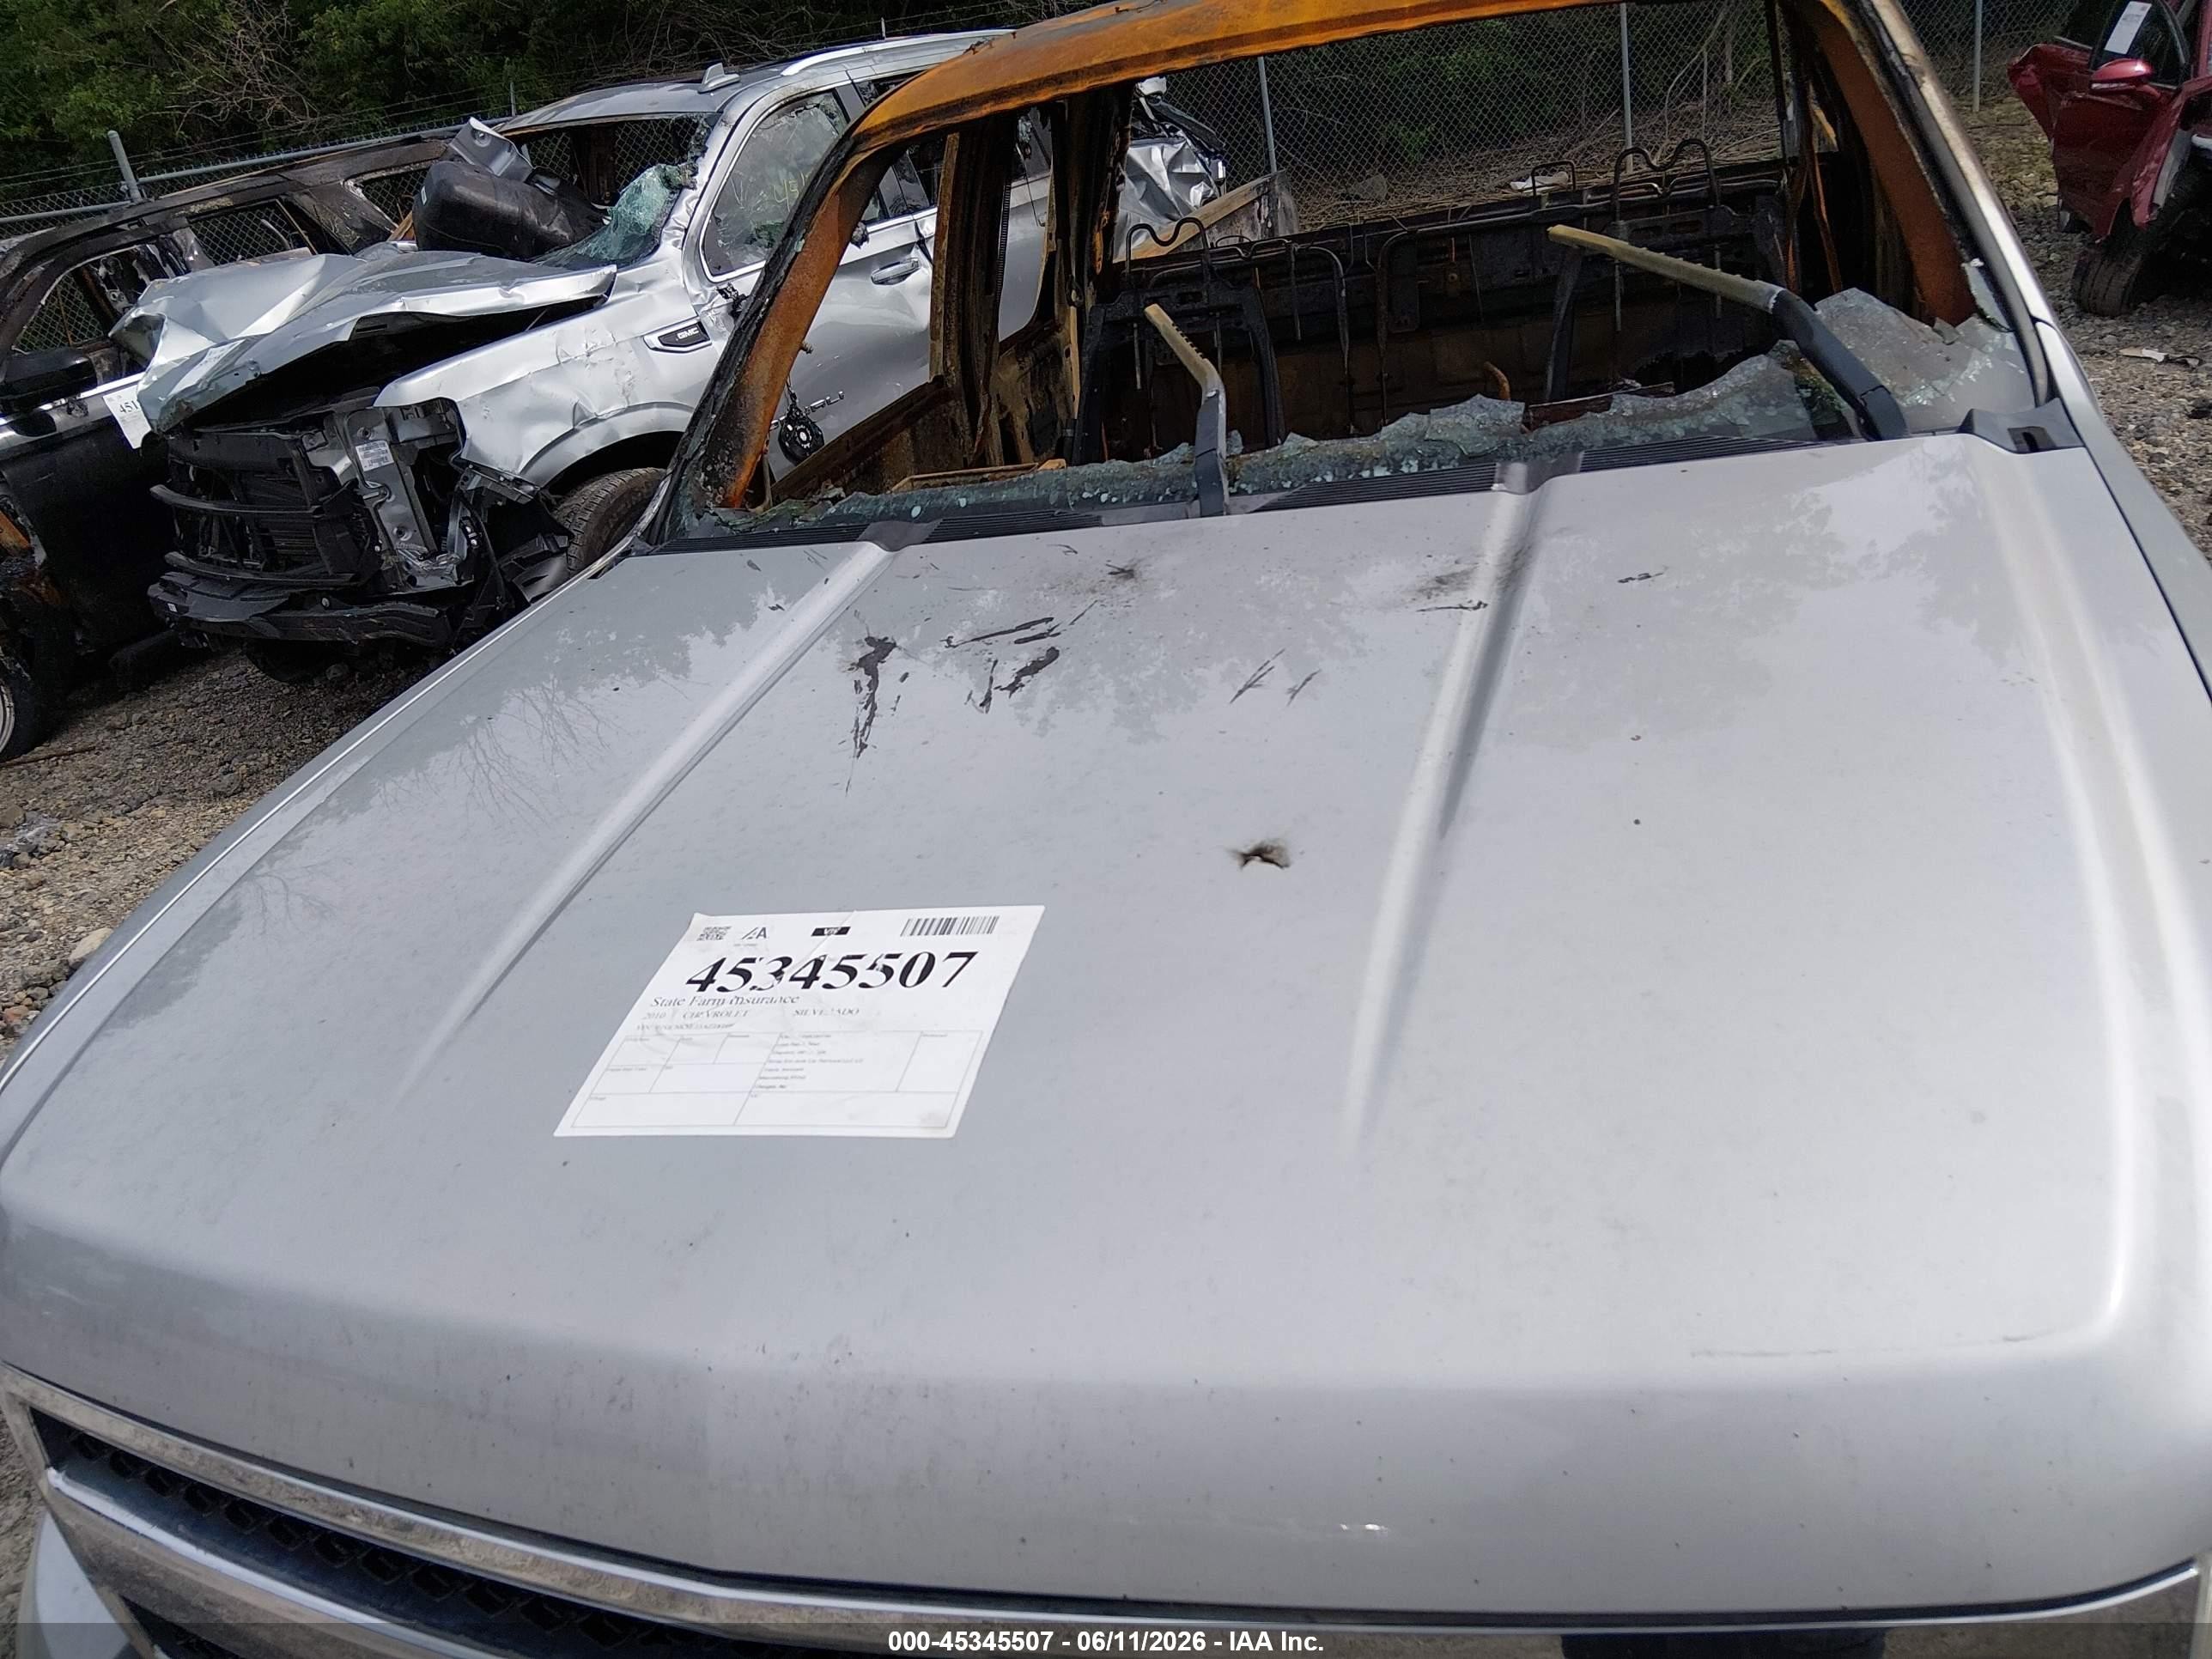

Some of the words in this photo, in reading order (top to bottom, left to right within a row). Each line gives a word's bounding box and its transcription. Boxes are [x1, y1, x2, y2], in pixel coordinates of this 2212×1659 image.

[677, 326, 700, 339] GMC
[685, 951, 978, 994] 45345507
[650, 996, 686, 1007] State
[688, 995, 726, 1006] Farm
